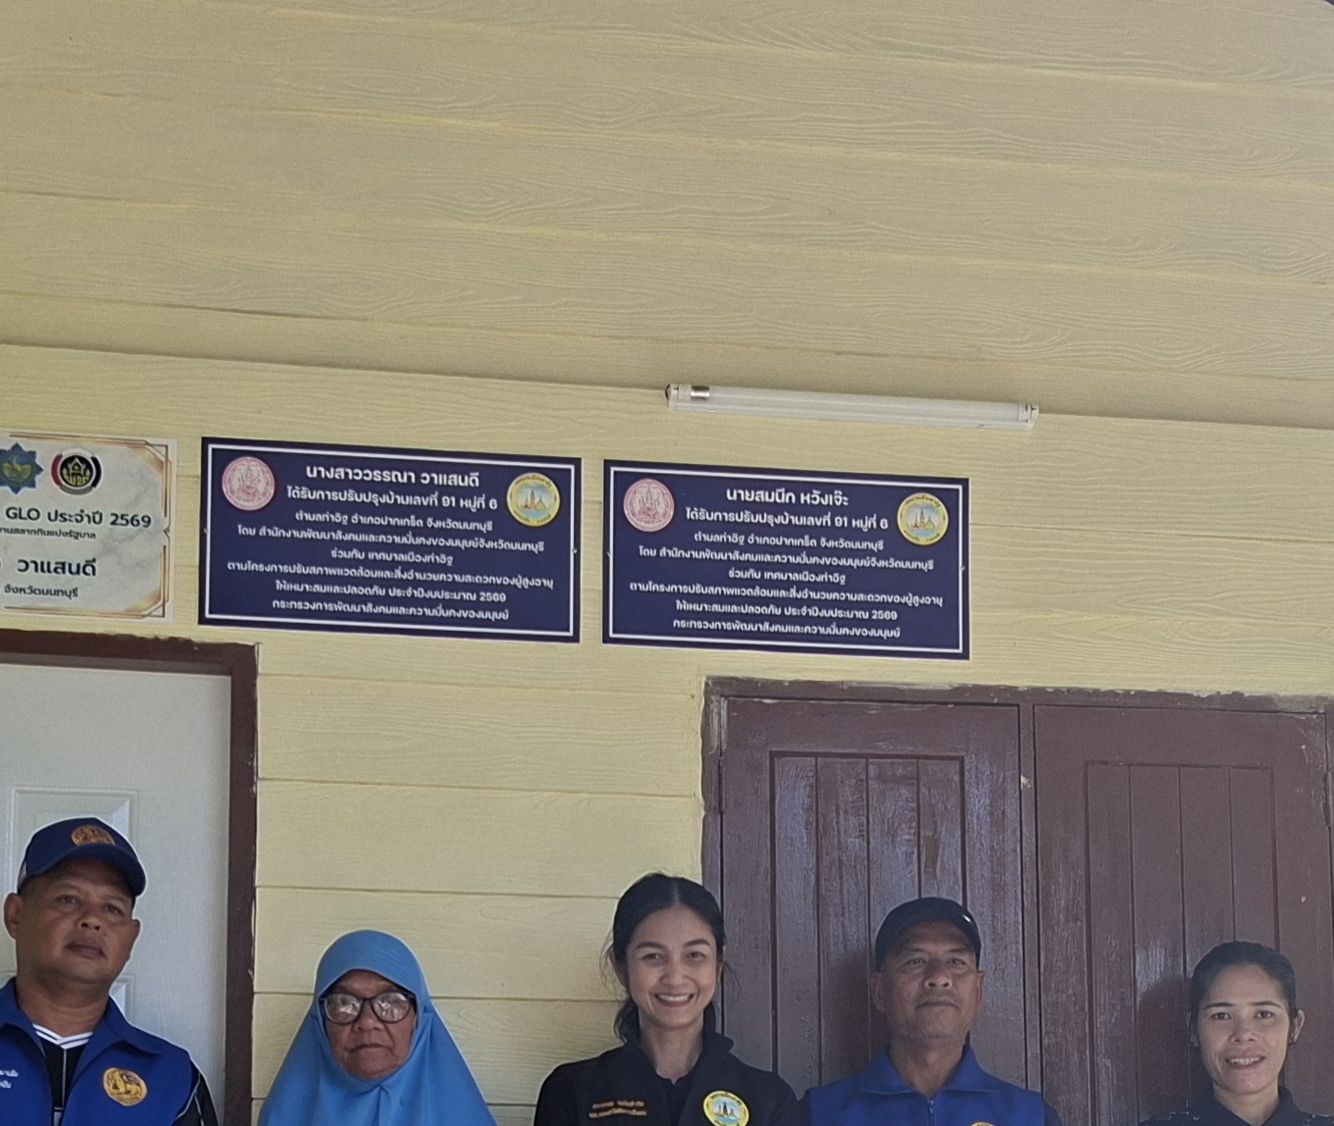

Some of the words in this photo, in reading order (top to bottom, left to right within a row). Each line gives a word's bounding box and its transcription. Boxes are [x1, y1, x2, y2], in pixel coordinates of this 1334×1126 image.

[306, 466, 416, 484] นางสาววรรณา
[420, 471, 480, 488] วาแสนดี
[286, 485, 439, 507] ได้รับการปรับปรุงบ้านเลขที่
[442, 496, 456, 507] 91
[460, 494, 486, 513] หมู่ที่
[489, 498, 498, 510] 6
[6, 506, 41, 521] GLO
[47, 508, 103, 526] ประจำปี
[110, 513, 153, 529] 2569
[351, 513, 423, 528] อำเภอปากเกร็ด
[426, 517, 493, 533] จังหวัดนนทบุรี
[685, 506, 831, 528] ได้รับการปรับปรุงบ้านเลขที่
[834, 516, 848, 528] 91
[852, 513, 877, 533] หมู่ที่
[880, 518, 889, 530] 6
[238, 524, 256, 537] โดย
[331, 546, 365, 560] ร่วมกับ
[639, 545, 657, 557] โดย
[747, 533, 817, 548] อำเภอปากเกร็ด
[820, 538, 884, 553] จังหวัดนนทบุรี
[17, 557, 97, 577] วาแสนดี
[728, 566, 761, 580] ร่วมกับ
[4, 584, 79, 600] จังหวัดนนทบุรี
